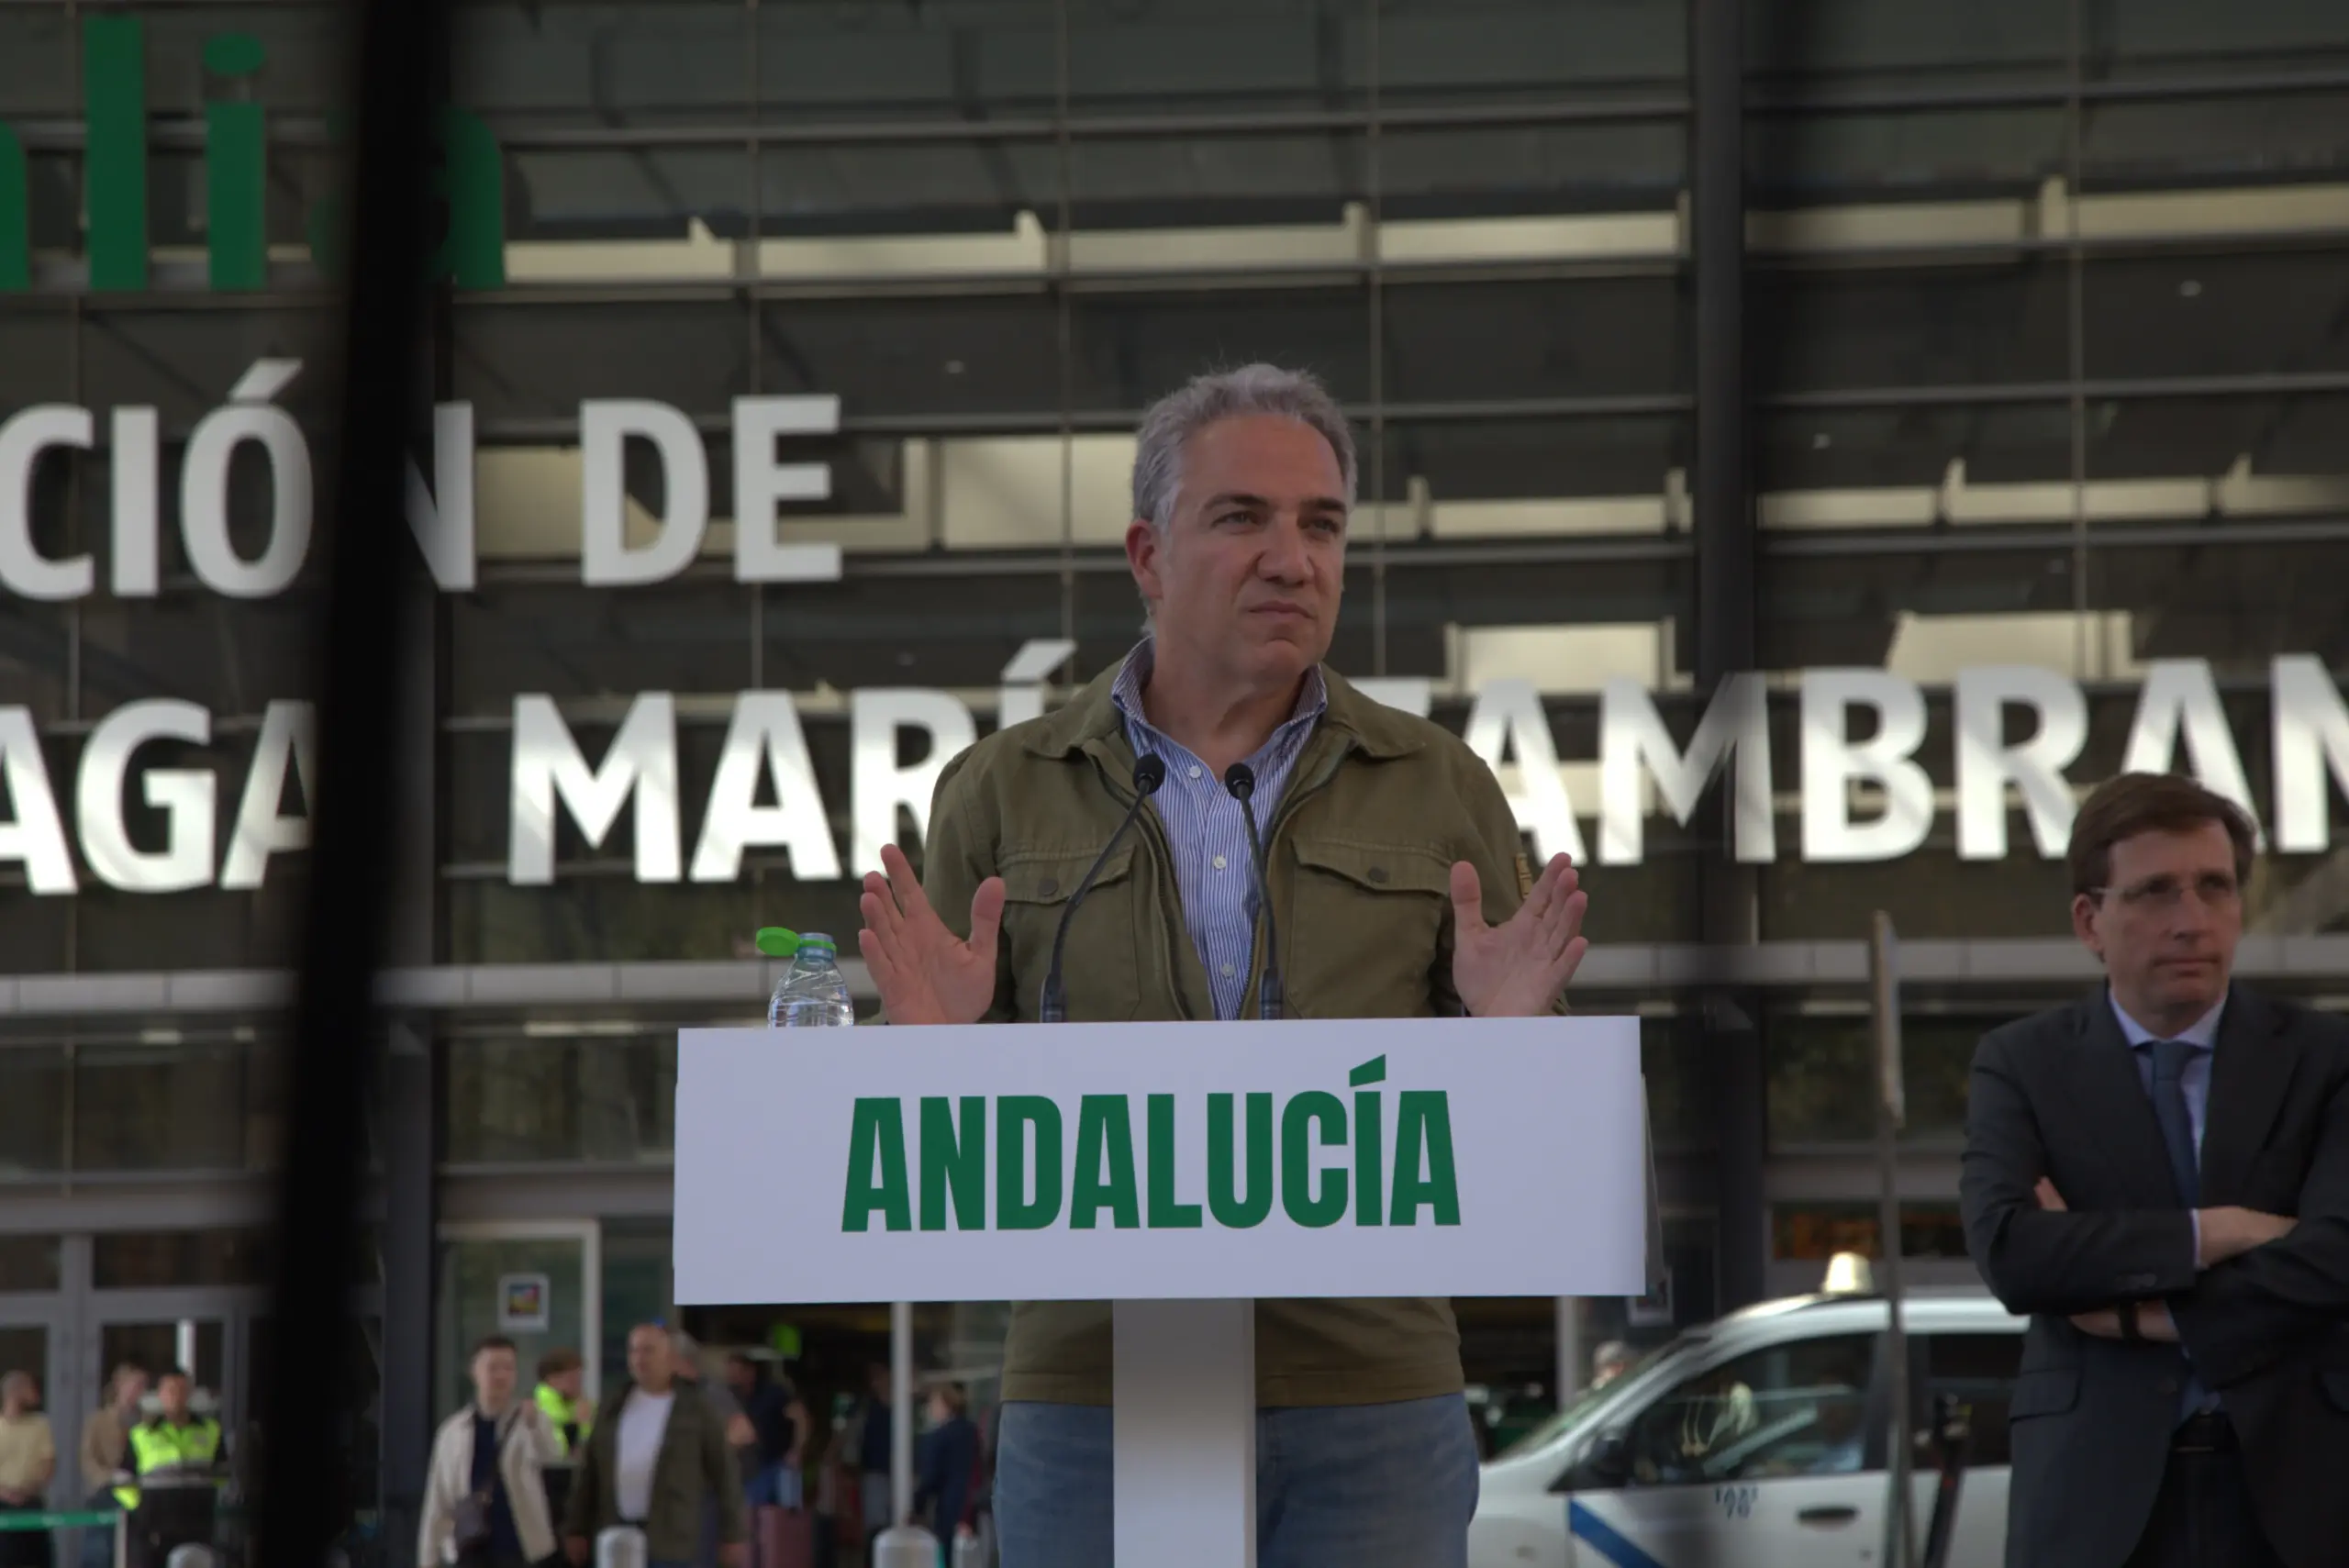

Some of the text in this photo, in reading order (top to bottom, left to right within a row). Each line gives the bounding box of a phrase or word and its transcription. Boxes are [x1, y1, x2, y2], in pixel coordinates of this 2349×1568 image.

[580, 395, 841, 586] DE
[1346, 653, 2349, 869] AMBRAN
[841, 1054, 1461, 1232] ANDALUCÍA
